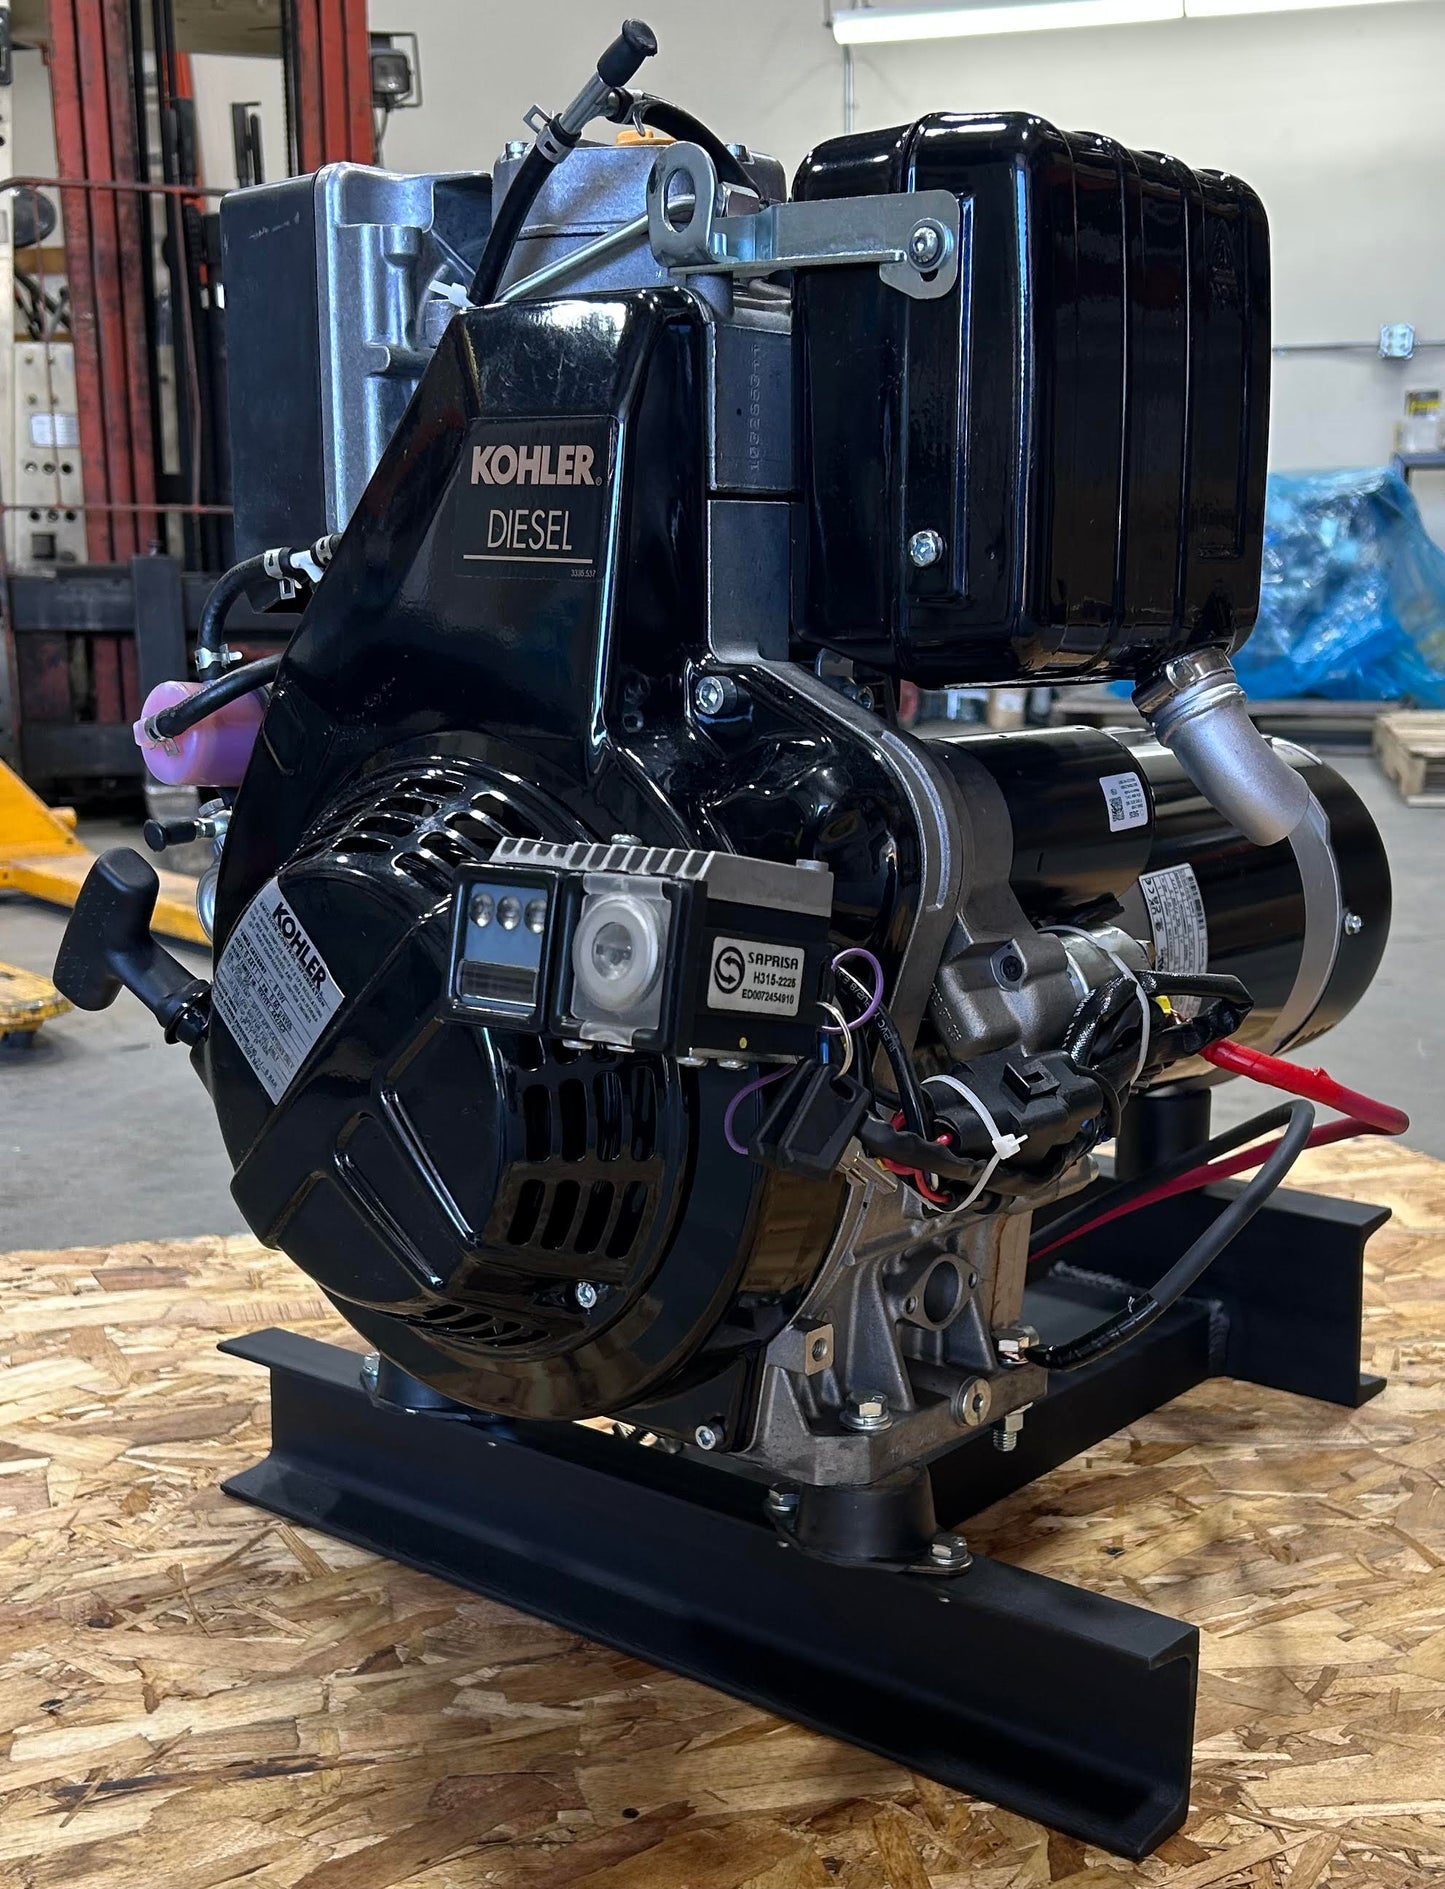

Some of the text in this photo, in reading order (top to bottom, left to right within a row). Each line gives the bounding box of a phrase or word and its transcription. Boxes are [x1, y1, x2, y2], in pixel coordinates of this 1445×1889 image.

[471, 444, 595, 485] KOHLER
[487, 509, 572, 550] DIESEL
[272, 901, 328, 991] KOHLER
[747, 951, 798, 970] SAPRISA
